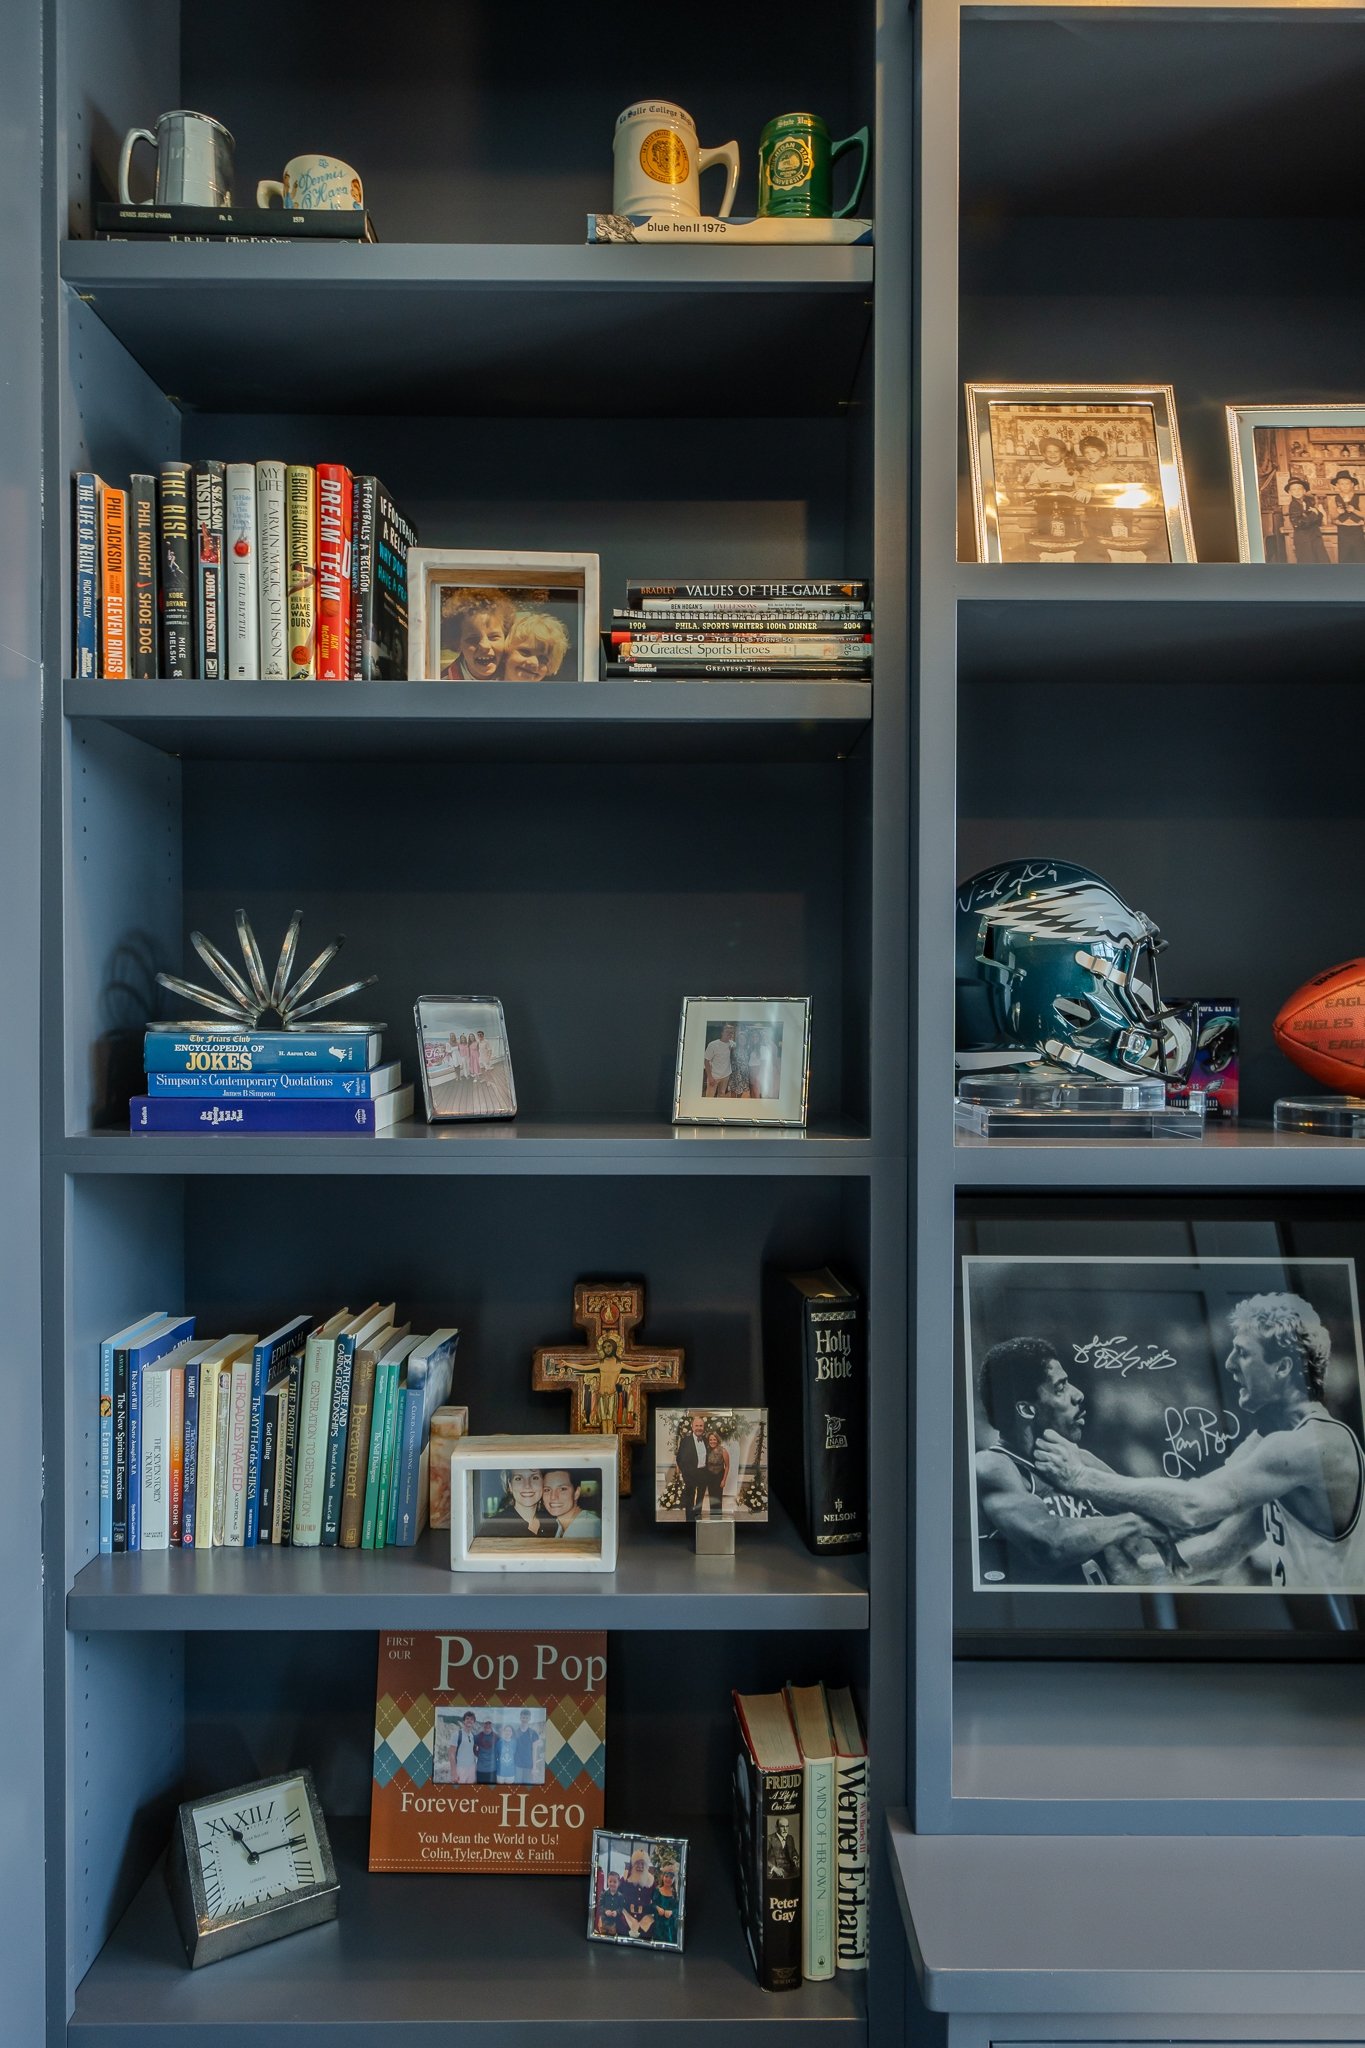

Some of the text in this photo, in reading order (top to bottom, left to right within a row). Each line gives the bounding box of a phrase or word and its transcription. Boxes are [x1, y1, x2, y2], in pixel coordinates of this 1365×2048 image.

[628, 107, 646, 118] Salle
[649, 106, 677, 117] College
[299, 166, 345, 194] Dennis
[647, 223, 670, 232] blue
[673, 224, 692, 232] hen
[702, 223, 727, 233] 1975
[259, 480, 283, 492] LIFE
[260, 468, 280, 479] MY
[292, 479, 307, 502] BIRD
[362, 483, 371, 493] IF
[107, 497, 121, 519] PHIL
[162, 470, 187, 539] THE RISE
[196, 474, 211, 530] INSIDE
[211, 474, 223, 530] A SEASON
[79, 485, 95, 574] THE LIFE OF REILLY
[361, 493, 372, 541] FOOTBALL'S
[107, 523, 122, 573] JACKSON
[138, 501, 151, 578] PHIL KNIGHT
[292, 515, 308, 566] JOHNSON
[320, 479, 341, 601] DREAM TEAM
[359, 555, 370, 595] RELIGION.
[686, 584, 832, 596] VALUES OF THE GAME
[83, 596, 91, 618] REILLY
[107, 596, 123, 635] ELEVEN
[205, 571, 216, 653] JOHN FEINSTEIN
[138, 592, 152, 654] SHOE DOG
[290, 618, 311, 628] OURS
[178, 637, 186, 658] MIKE
[650, 644, 770, 657] Greatest Sports Heroes
[686, 634, 704, 642] 5-0
[108, 639, 123, 672] RINGS
[1293, 1018, 1353, 1032] EAGLES
[174, 1044, 264, 1053] ENCYCLOPEDIA OF
[189, 1035, 205, 1043] The
[207, 1035, 231, 1043] Friars
[186, 1052, 252, 1071] JOKES
[156, 1074, 333, 1088] Simpson's Contemporary Quotations
[815, 1329, 852, 1356] Holy
[815, 1356, 852, 1382] Bible
[330, 1343, 344, 1437] CARING RELATIONSHIPS
[252, 1396, 260, 1412] The
[307, 1380, 320, 1439] GENERATION
[232, 1372, 247, 1491] THE ROAD LESS TRAVELED
[251, 1413, 259, 1443] MYTH
[286, 1404, 296, 1448] PROPHET
[115, 1393, 126, 1500] The New Spiritual Exercises
[249, 1454, 258, 1465] the
[250, 1444, 259, 1453] of
[264, 1437, 272, 1460] Calling
[306, 1442, 315, 1455] TO
[345, 1403, 368, 1498] Bereavement
[372, 1443, 380, 1456] Nell
[145, 1452, 153, 1488] MOUNTAIN
[285, 1454, 293, 1488] KAHLIL
[369, 1456, 378, 1483] Dialogues
[153, 1476, 161, 1503] STOREY
[248, 1466, 257, 1500] SHIKSA
[302, 1457, 314, 1517] GENERATION
[282, 1489, 291, 1523] GIBRAN
[823, 1512, 857, 1523] NELSON
[386, 1637, 415, 1647] FIRST
[388, 1650, 412, 1660] OUR
[433, 1635, 607, 1692] Pop Pop
[765, 1775, 802, 1790] FREUD
[233, 1806, 263, 1829] XII
[401, 1791, 585, 1828] Forever our Hero
[418, 1832, 560, 1845] You Mean the World to Us!
[816, 1773, 827, 1900] A MIND OF HER OWN
[514, 1849, 525, 1860] &
[528, 1848, 555, 1861] Faith
[837, 1761, 866, 1960] Werner Erhard
[769, 1897, 799, 1910] Peter
[772, 1910, 795, 1922] Gay
